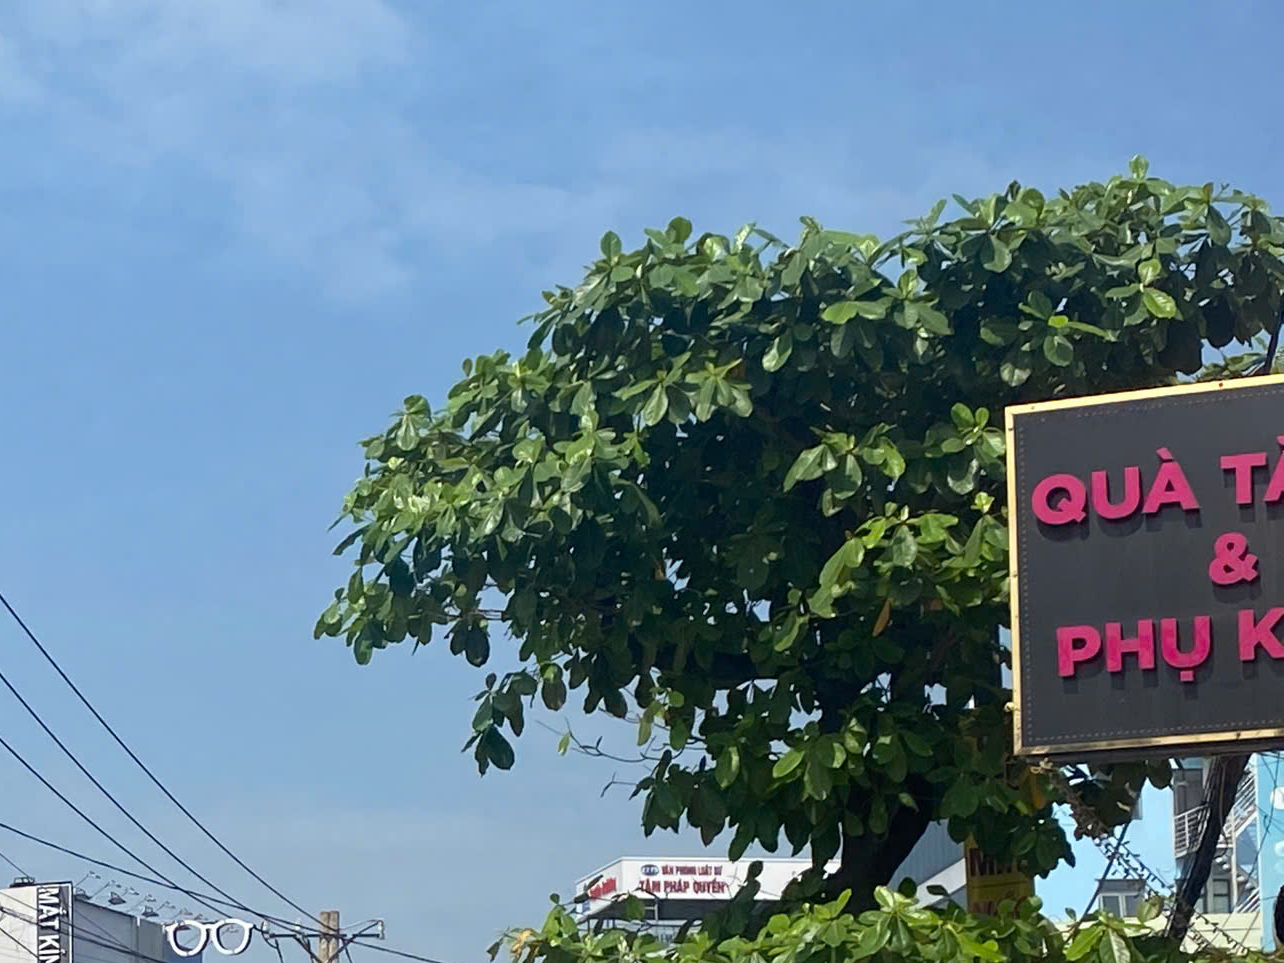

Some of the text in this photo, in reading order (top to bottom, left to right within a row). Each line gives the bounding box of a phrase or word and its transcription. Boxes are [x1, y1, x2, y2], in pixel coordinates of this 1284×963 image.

[1032, 447, 1200, 525] QUÀ
[1209, 532, 1259, 586] &
[1056, 615, 1211, 682] PHỤ
